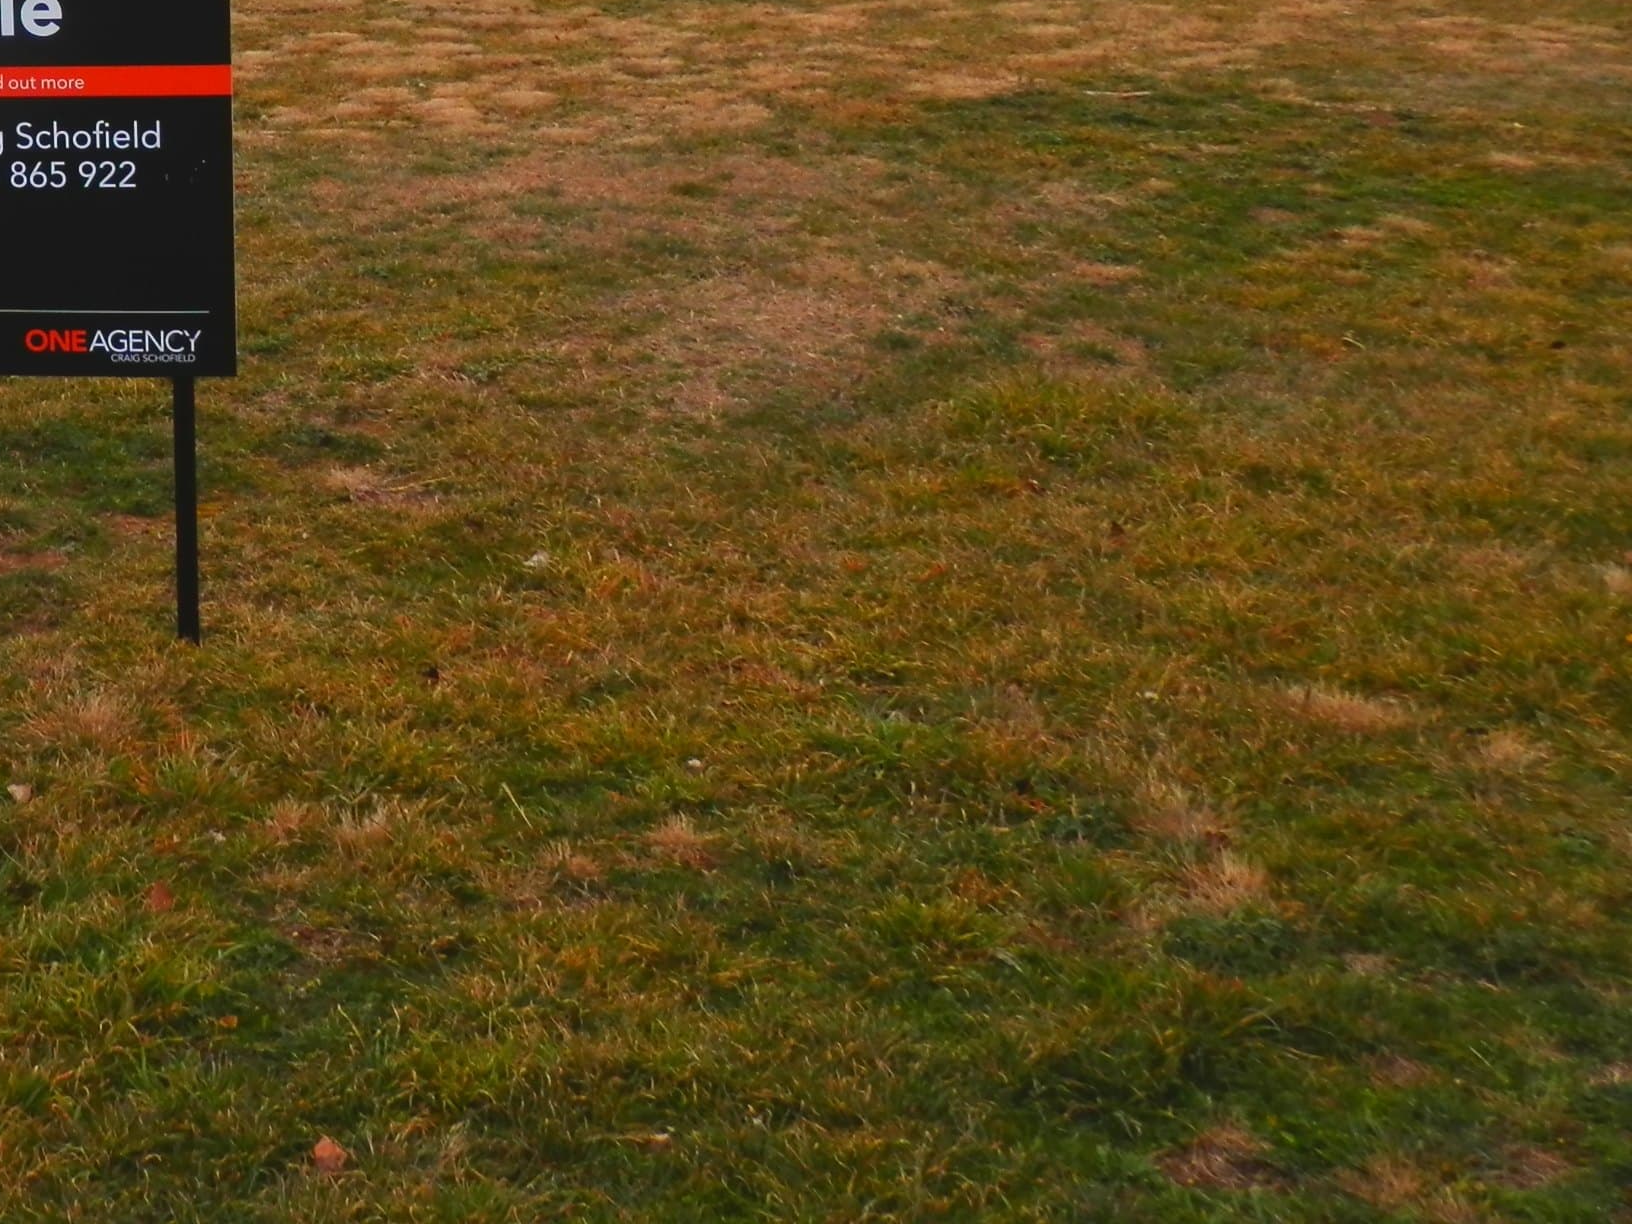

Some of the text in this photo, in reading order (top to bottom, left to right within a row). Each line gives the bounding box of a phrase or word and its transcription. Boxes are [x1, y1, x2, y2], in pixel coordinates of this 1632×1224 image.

[8, 76, 36, 90] out
[41, 77, 85, 90] more
[15, 120, 161, 150] Schofield
[10, 162, 67, 188] 865
[78, 162, 137, 188] 922
[110, 353, 196, 363] CRAIG SCHOFIELD
